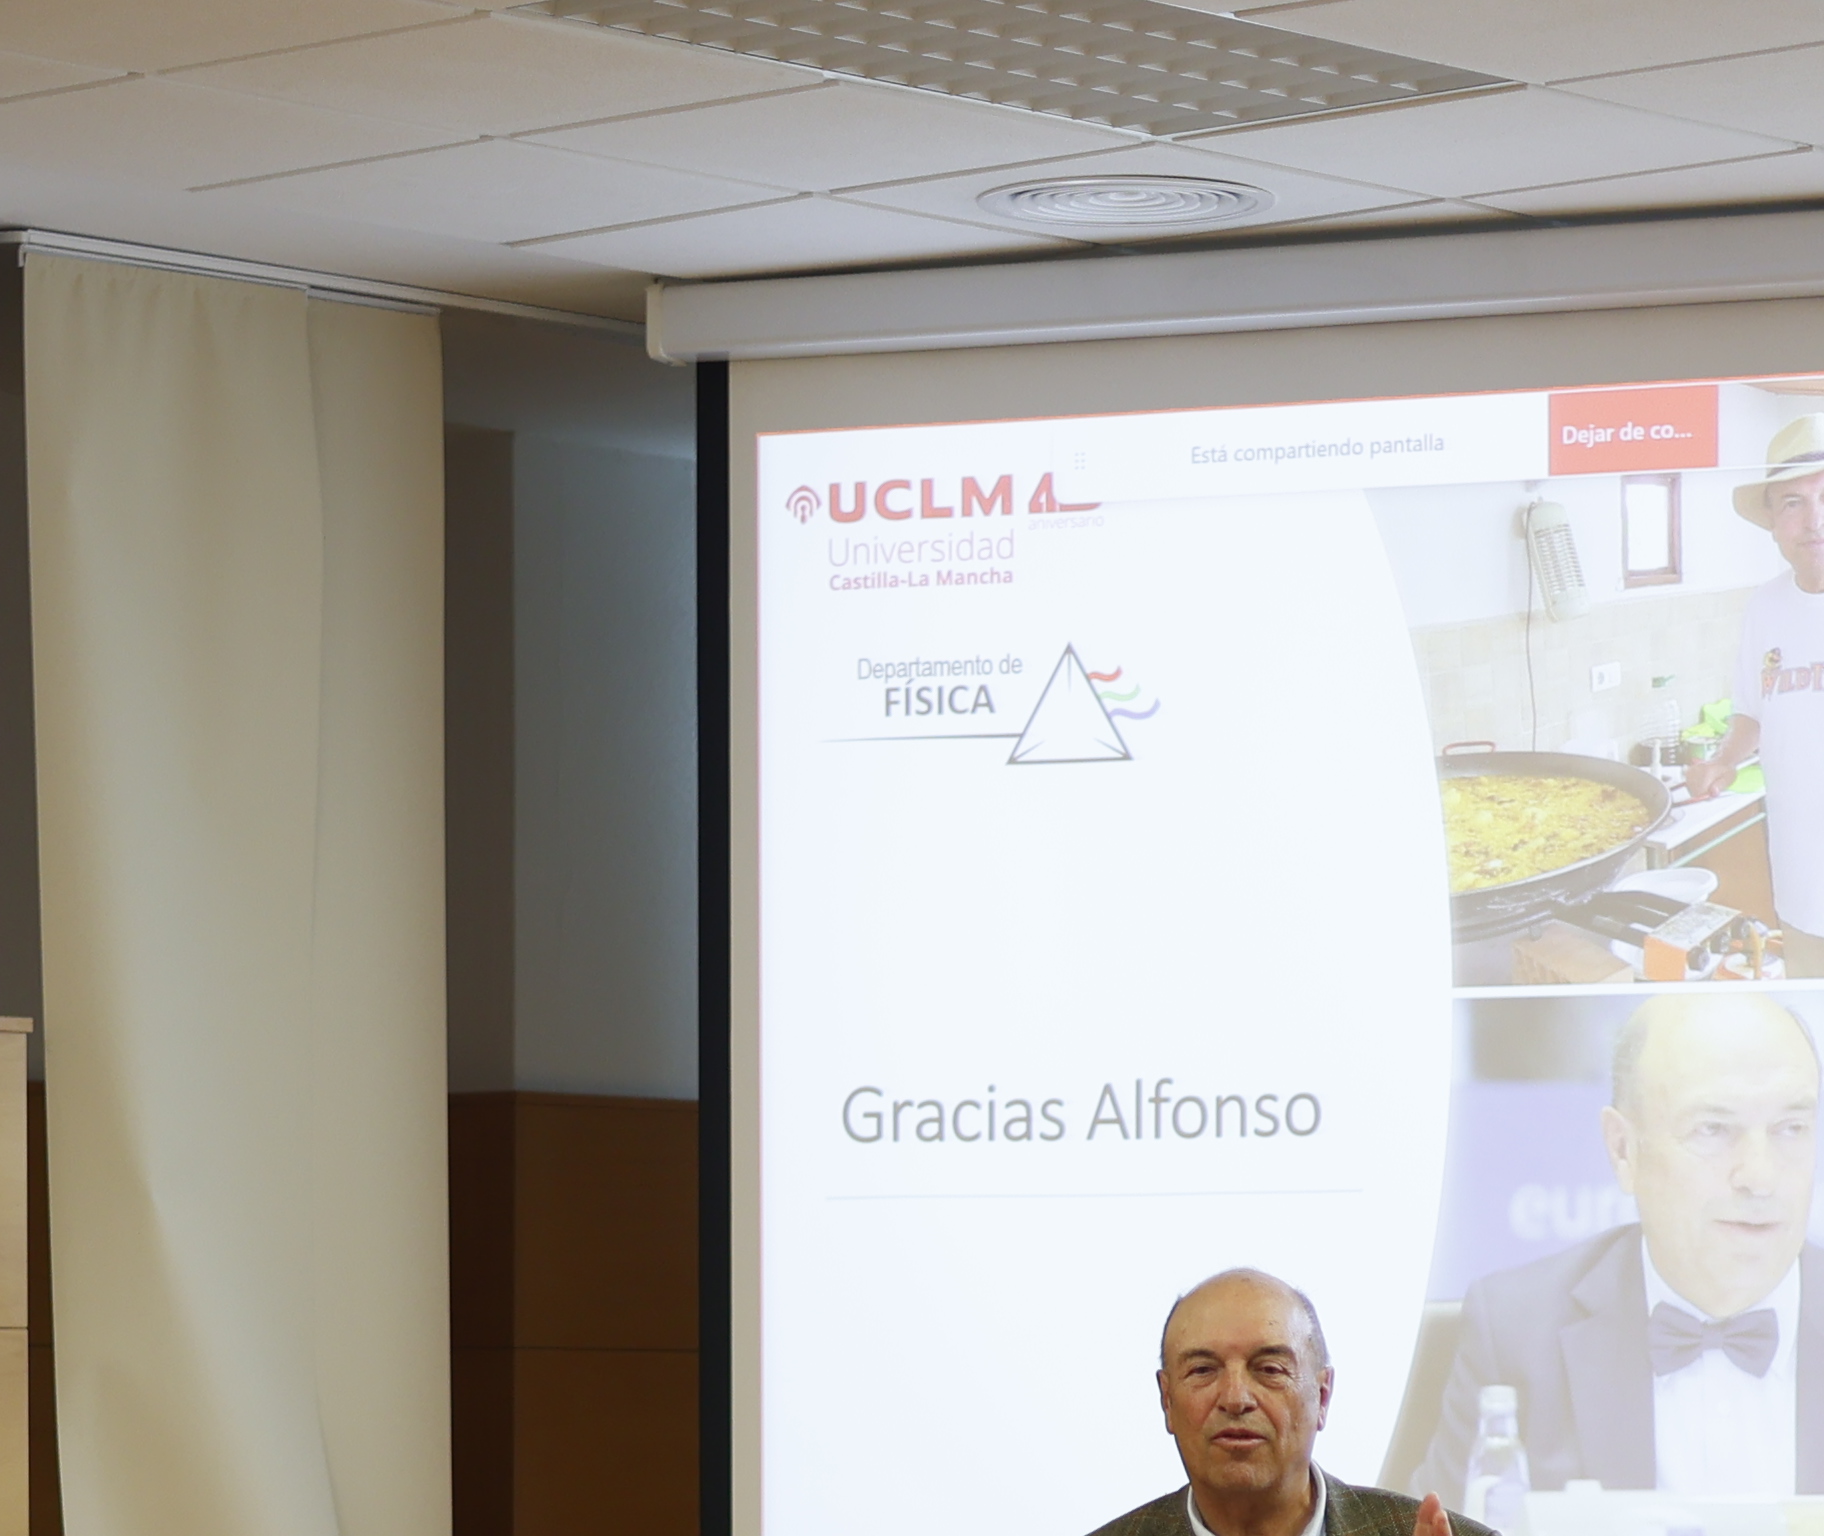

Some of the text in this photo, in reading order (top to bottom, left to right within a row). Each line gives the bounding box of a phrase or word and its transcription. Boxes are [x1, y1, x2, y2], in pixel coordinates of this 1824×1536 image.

[1191, 433, 1445, 465] Está compartiendo pantalla
[1561, 423, 1615, 450] Dejar
[1619, 420, 1645, 443] de
[828, 474, 1013, 524] UCLM
[827, 529, 1016, 567] Universidad
[829, 566, 1014, 591] Castilla-La Mancha
[857, 653, 1023, 684] Departamento de
[884, 678, 996, 718] FÍSICA
[842, 1077, 1323, 1143] Gracias Alfonso
